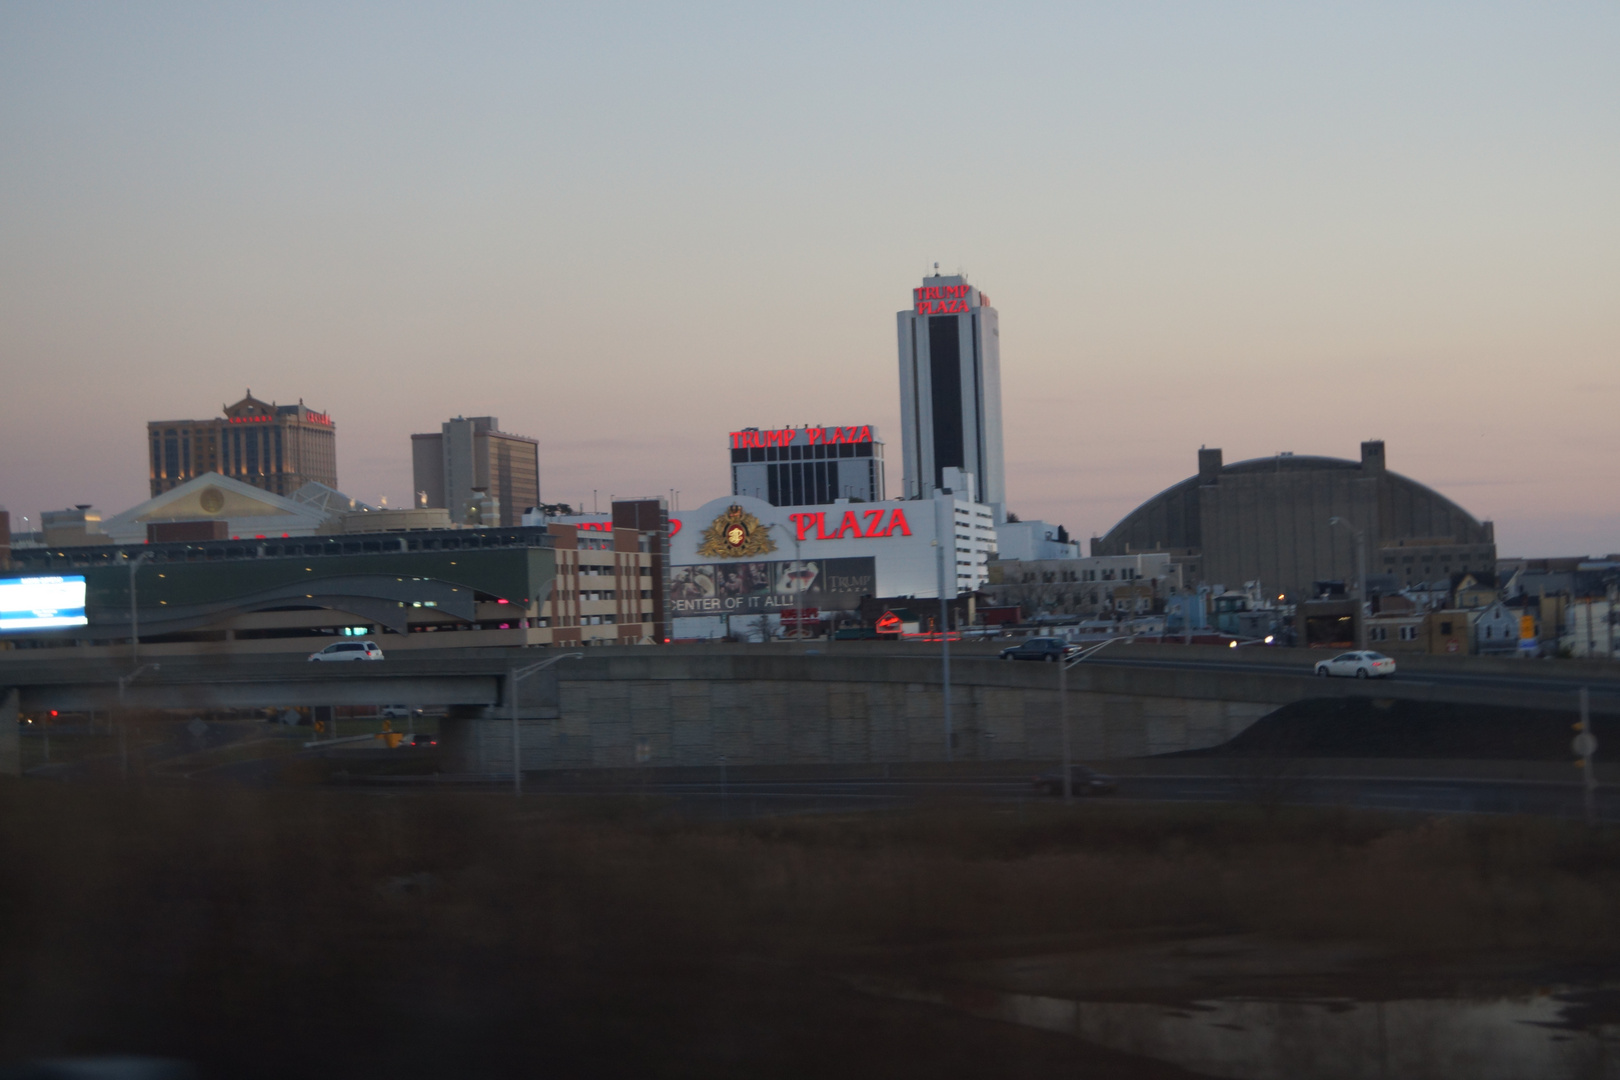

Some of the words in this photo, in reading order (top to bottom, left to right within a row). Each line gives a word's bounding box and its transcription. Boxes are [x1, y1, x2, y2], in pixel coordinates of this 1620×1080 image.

[914, 285, 970, 300] TRUMP
[916, 299, 970, 315] PLAZA
[729, 429, 796, 450] TRUMP
[805, 425, 873, 446] PLAZA
[789, 508, 912, 541] PLAZA
[828, 575, 872, 587] TRUMP
[725, 597, 744, 609] OF
[748, 596, 760, 608] IT
[764, 595, 794, 607] ALL!
